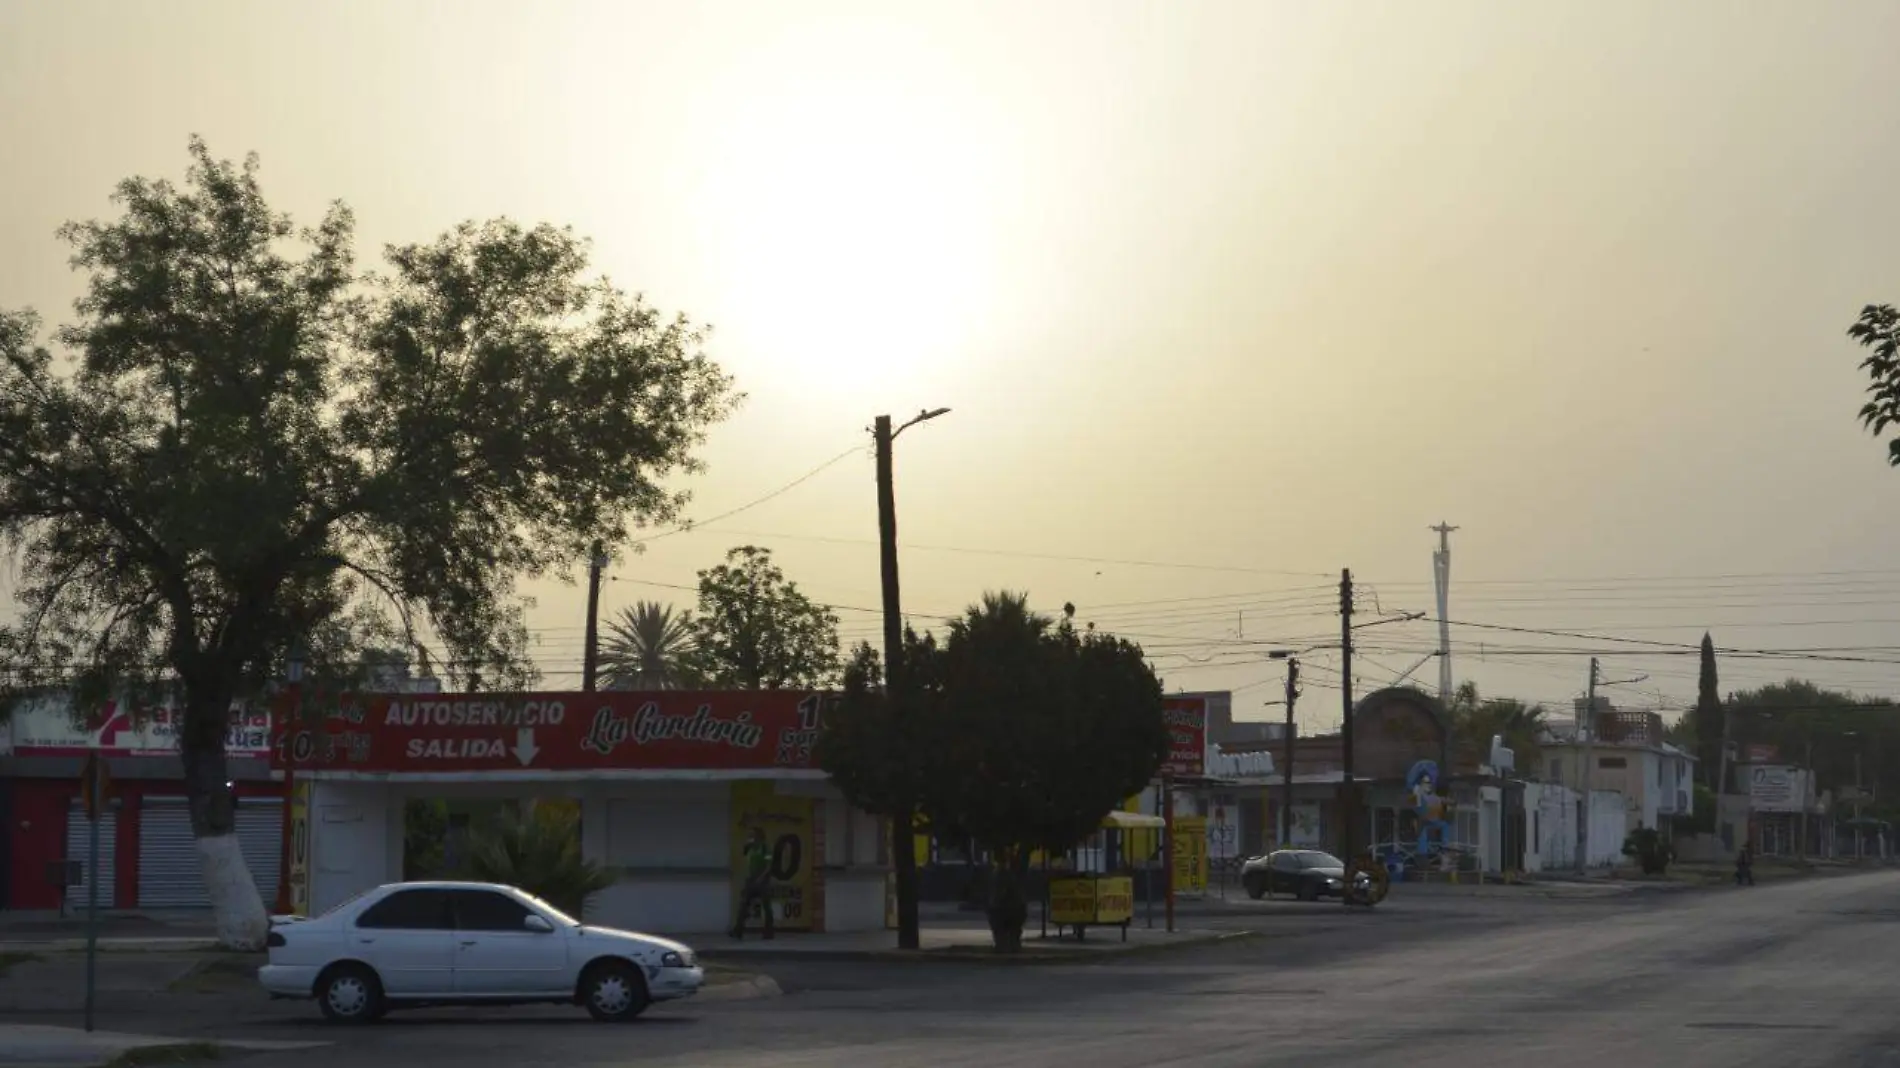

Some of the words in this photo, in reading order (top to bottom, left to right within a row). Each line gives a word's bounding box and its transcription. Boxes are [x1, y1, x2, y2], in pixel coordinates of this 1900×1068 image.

[384, 701, 565, 725] AUTOSERVICIO
[580, 705, 627, 755] La
[631, 700, 762, 748] Gordería
[406, 738, 506, 759] SALIDA
